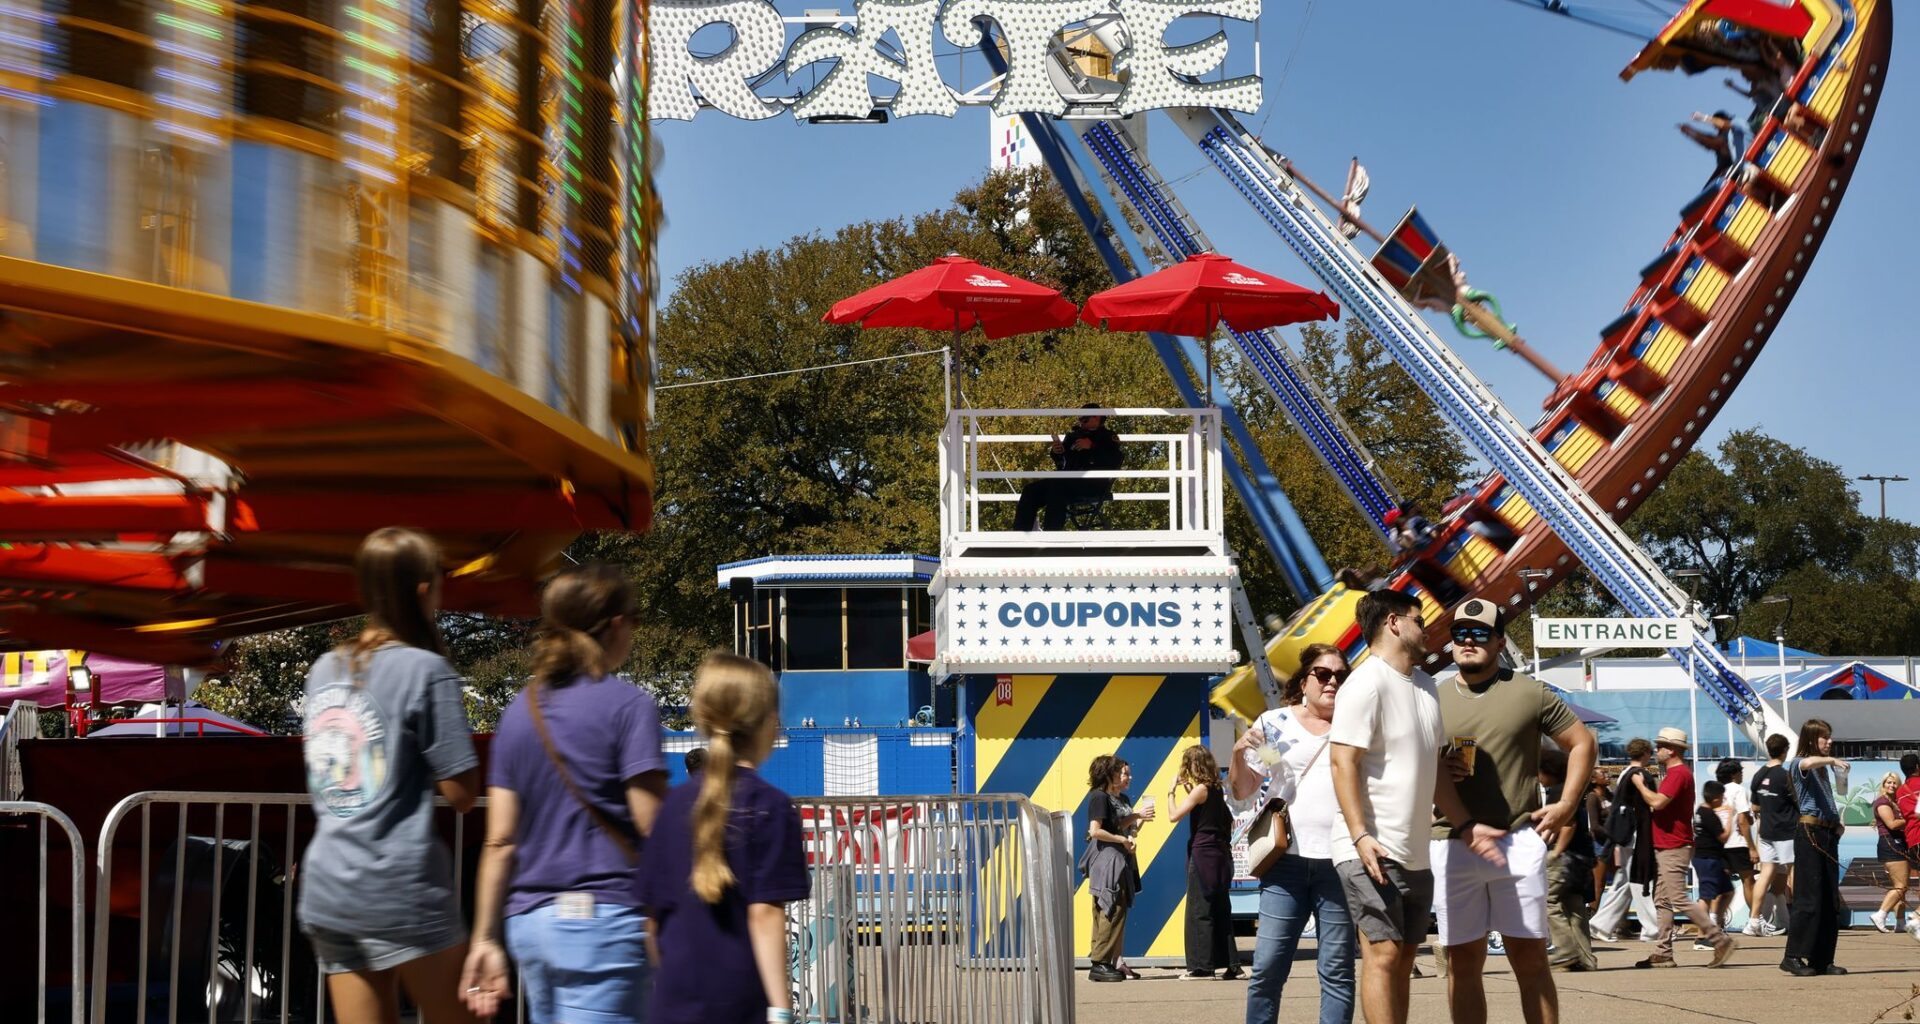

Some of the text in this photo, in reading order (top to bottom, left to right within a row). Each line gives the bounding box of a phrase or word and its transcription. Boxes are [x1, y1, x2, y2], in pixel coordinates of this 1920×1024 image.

[998, 601, 1182, 628] COUPONS
[1548, 624, 1678, 640] ENTRANCE
[997, 682, 1012, 700] 08
